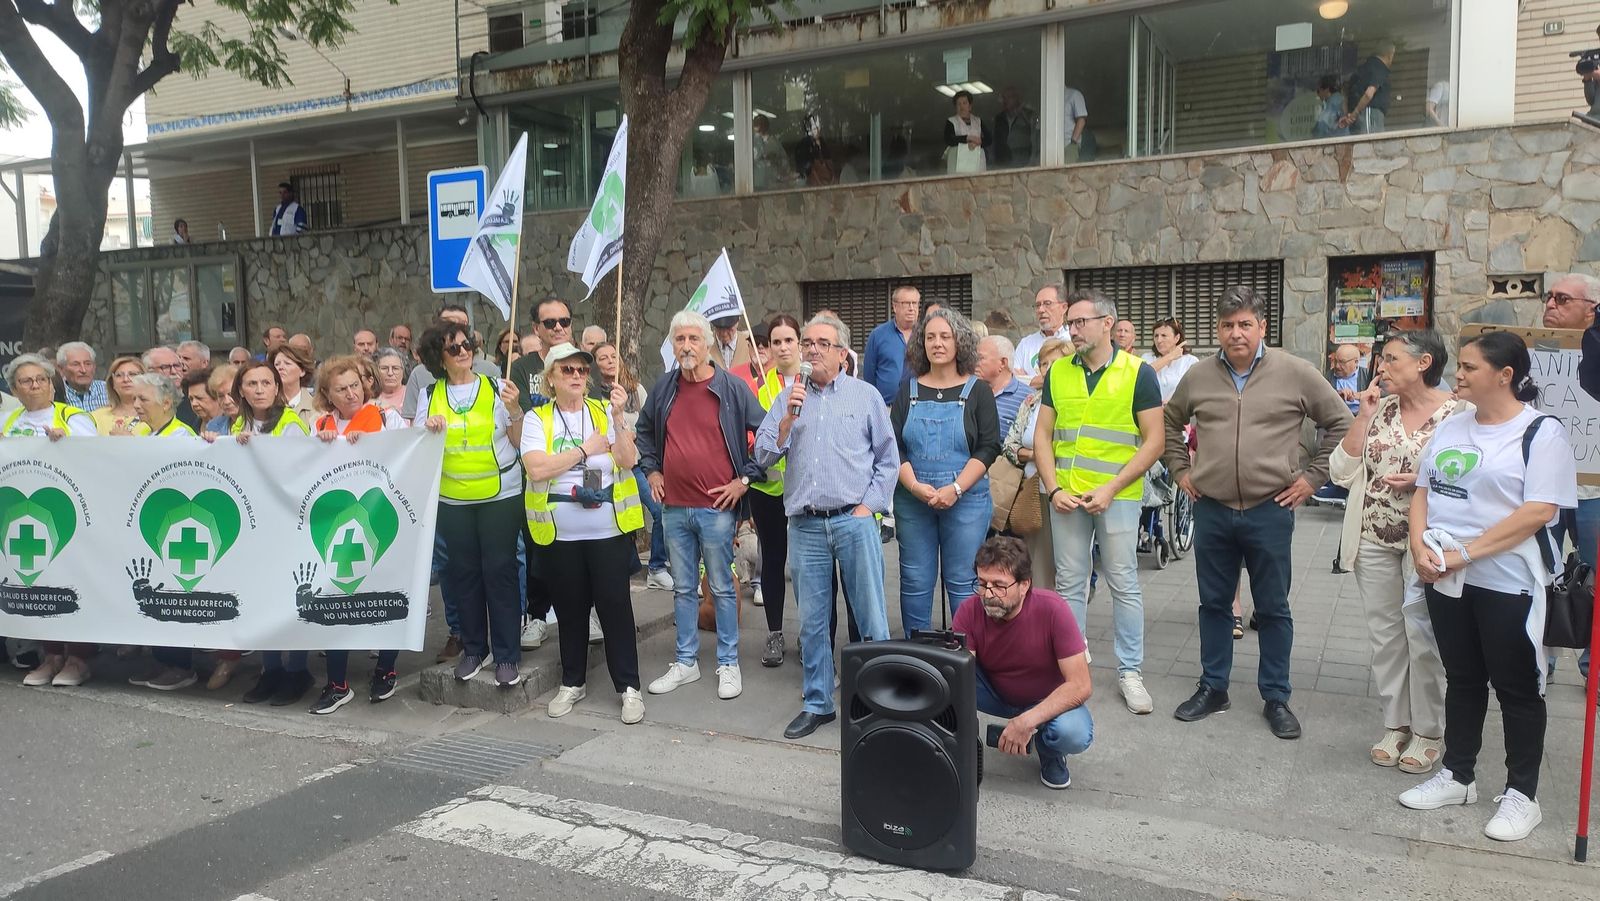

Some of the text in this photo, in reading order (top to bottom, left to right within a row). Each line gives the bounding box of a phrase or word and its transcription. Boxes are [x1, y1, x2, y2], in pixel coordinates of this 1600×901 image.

[2, 460, 31, 472] DEFENSA
[44, 462, 52, 471] LA
[54, 467, 79, 493] SANIDAD
[126, 479, 152, 528] PLATAFORMA
[151, 470, 161, 481] EN
[160, 460, 192, 474] DEFENSA
[194, 460, 205, 468] DE
[206, 463, 216, 473] LA
[216, 468, 243, 495] SANIDAD
[297, 480, 321, 531] PLATAFORMA
[321, 471, 333, 482] EN
[333, 459, 365, 474] DEFENSA
[365, 459, 372, 467] DE
[393, 489, 417, 525] PÚBLICA
[3, 592, 20, 600] SALUD
[16, 602, 25, 610] UN
[25, 603, 57, 611] NEGOCIO!
[155, 598, 178, 607] SALUD
[179, 599, 187, 607] ES
[200, 600, 235, 608] DERECHO,
[314, 602, 341, 612] SALUD
[342, 601, 352, 609] ES
[354, 601, 366, 609] UN
[367, 599, 405, 608] DERECHO,
[160, 608, 171, 616] NO
[183, 609, 216, 618] NEGOCIO!
[323, 610, 387, 620] NO UN NEGOCIO!
